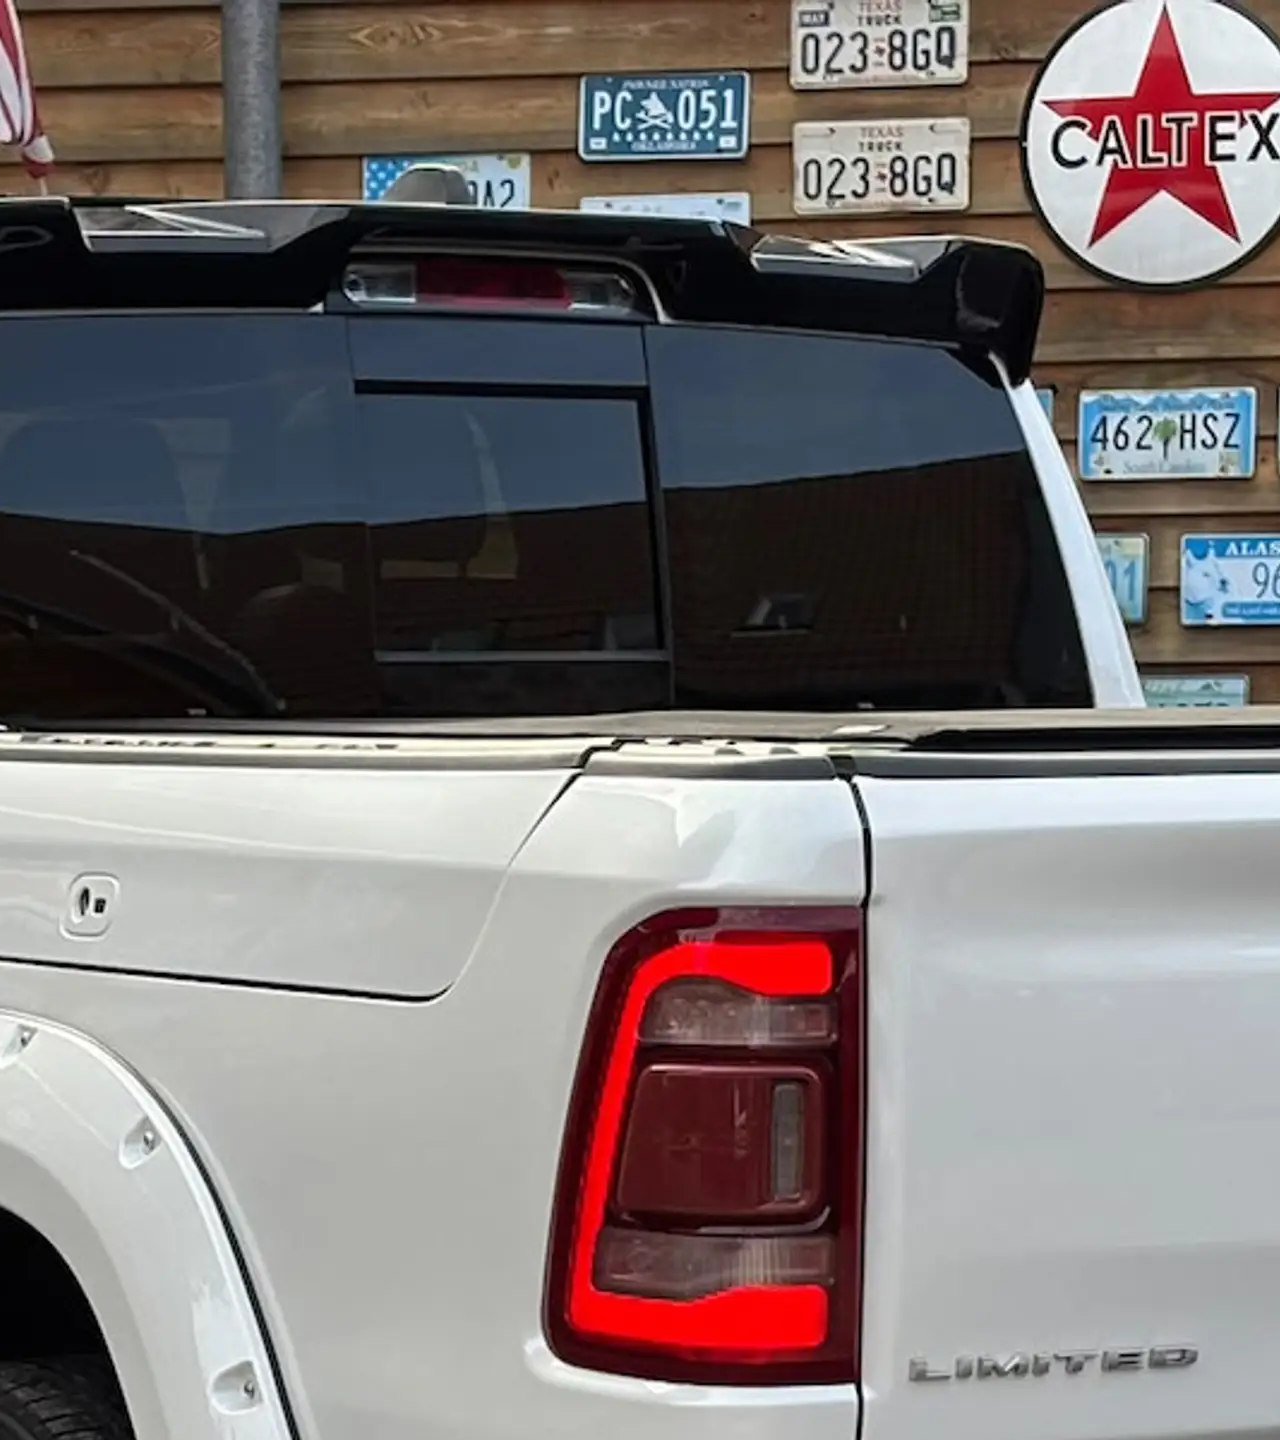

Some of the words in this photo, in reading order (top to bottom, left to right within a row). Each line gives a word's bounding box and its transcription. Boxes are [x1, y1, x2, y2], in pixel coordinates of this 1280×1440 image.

[801, 31, 869, 76] 023
[888, 26, 955, 71] 8GQ
[592, 90, 634, 130] PC
[677, 88, 738, 130] 051
[803, 157, 870, 200] 023
[889, 152, 956, 196] 8GQ
[1090, 414, 1154, 451] 462
[1179, 411, 1241, 450] HSZ
[908, 1347, 1200, 1383] LIMITED
